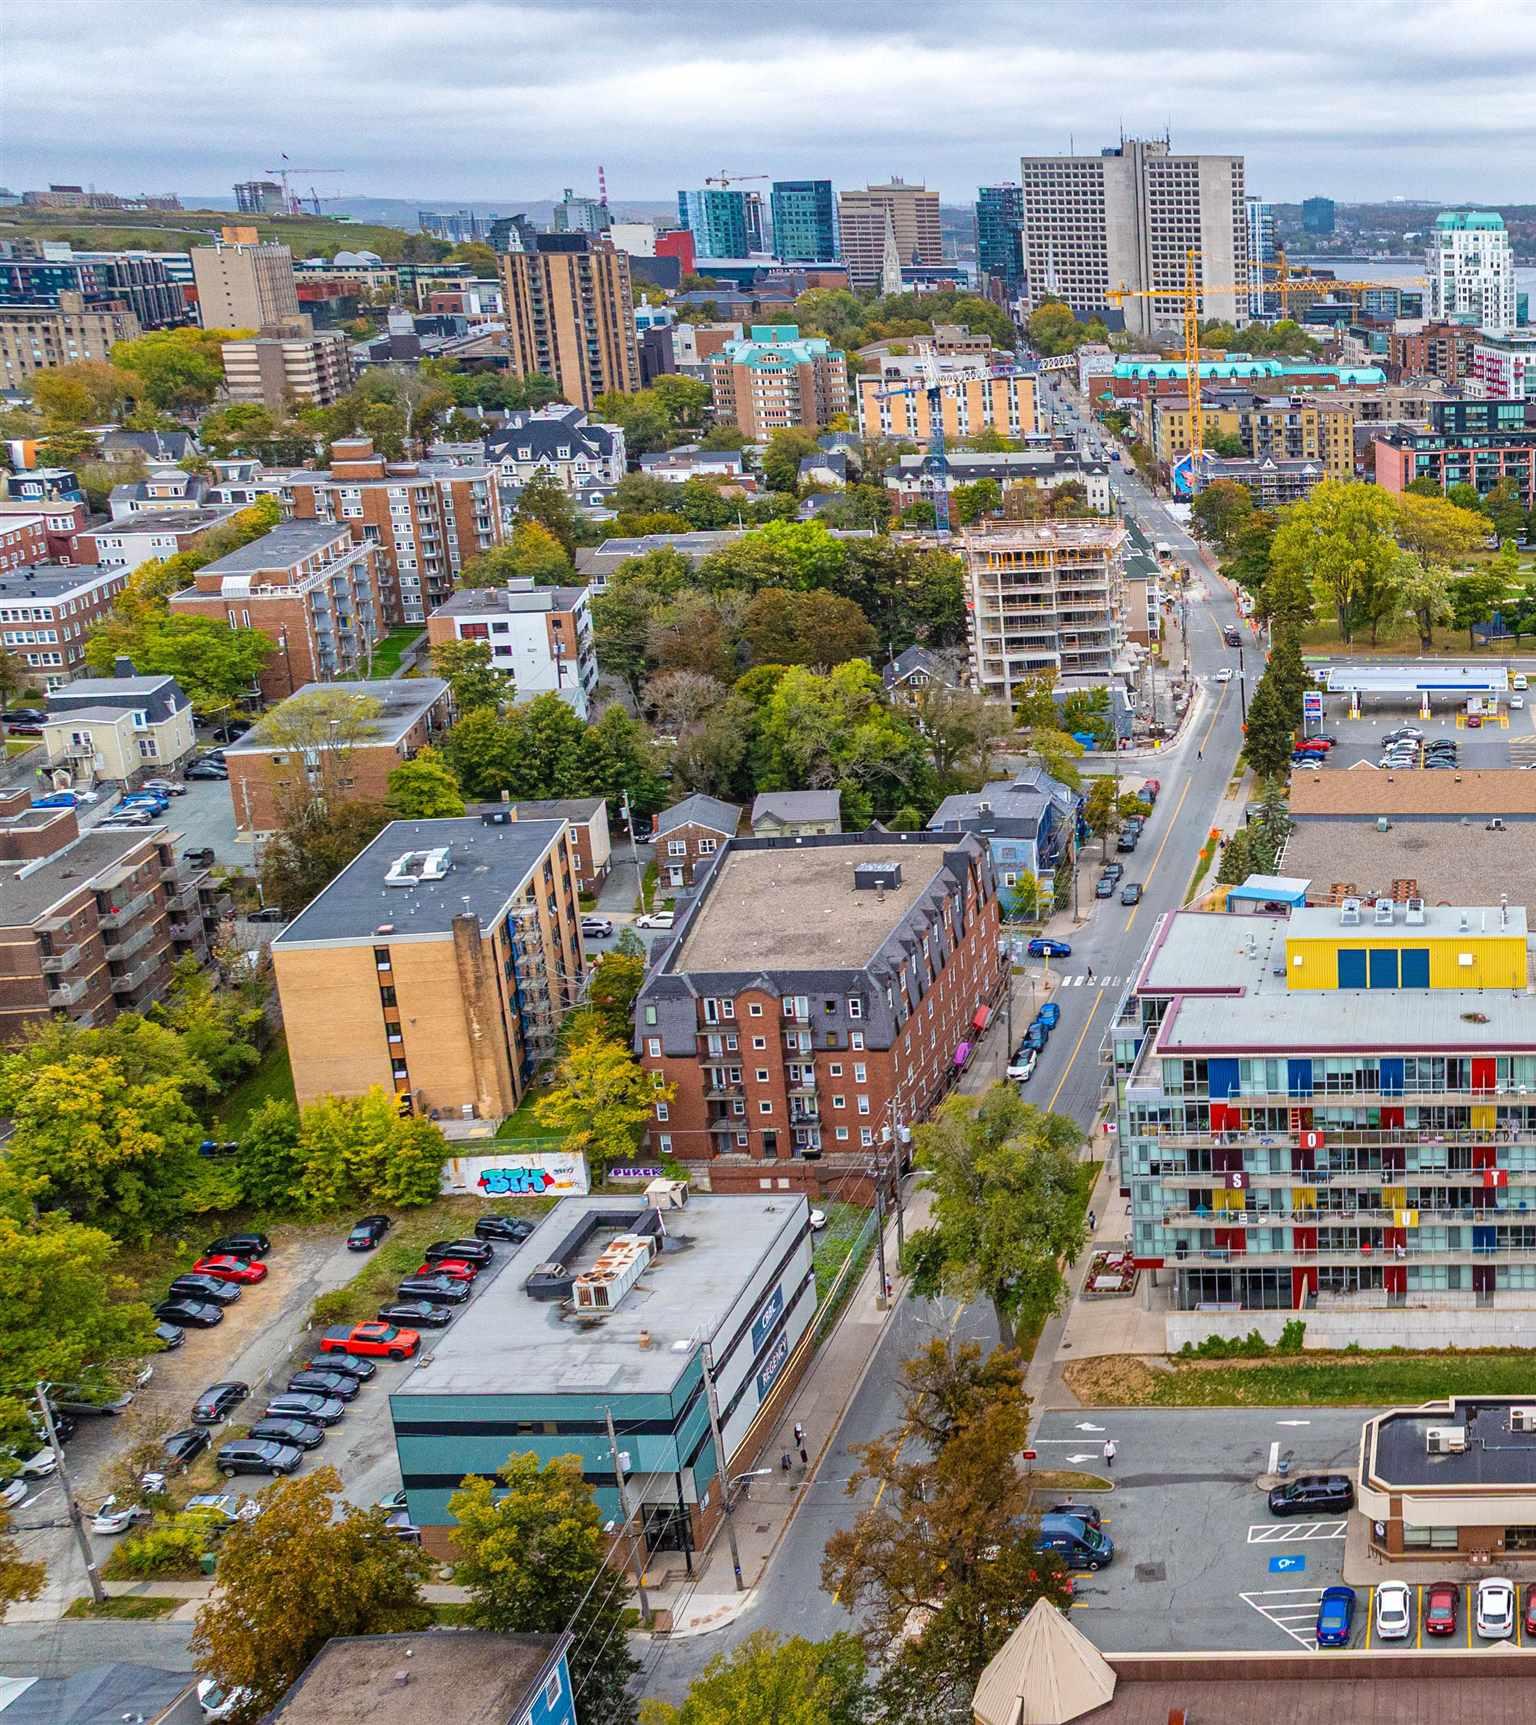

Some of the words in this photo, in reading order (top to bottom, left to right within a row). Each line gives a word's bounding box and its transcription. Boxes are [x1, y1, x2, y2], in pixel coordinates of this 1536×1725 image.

[1233, 1173, 1242, 1188] S
[1307, 1132, 1317, 1148] O
[1401, 1211, 1411, 1226] U
[1490, 1170, 1500, 1186] T
